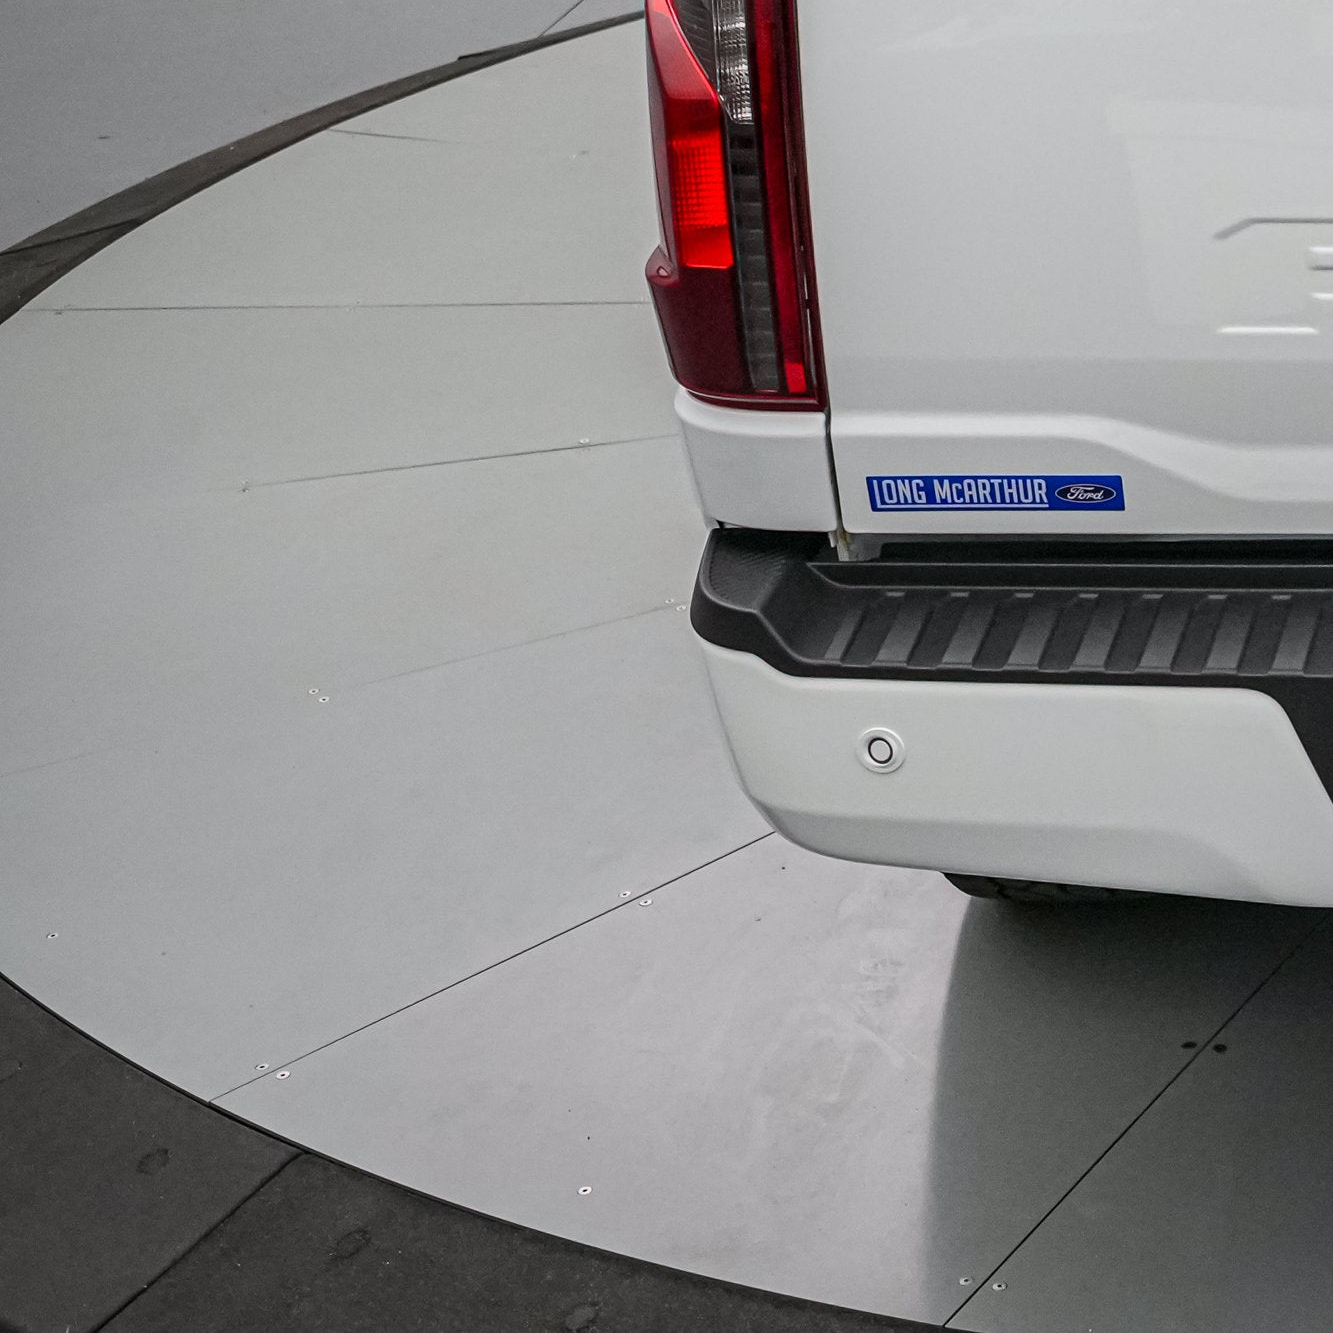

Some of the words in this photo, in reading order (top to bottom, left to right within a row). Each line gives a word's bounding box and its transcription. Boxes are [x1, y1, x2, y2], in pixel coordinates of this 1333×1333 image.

[872, 478, 926, 507] LONG
[932, 478, 1049, 504] McARTHUR
[1066, 486, 1104, 500] Ford
